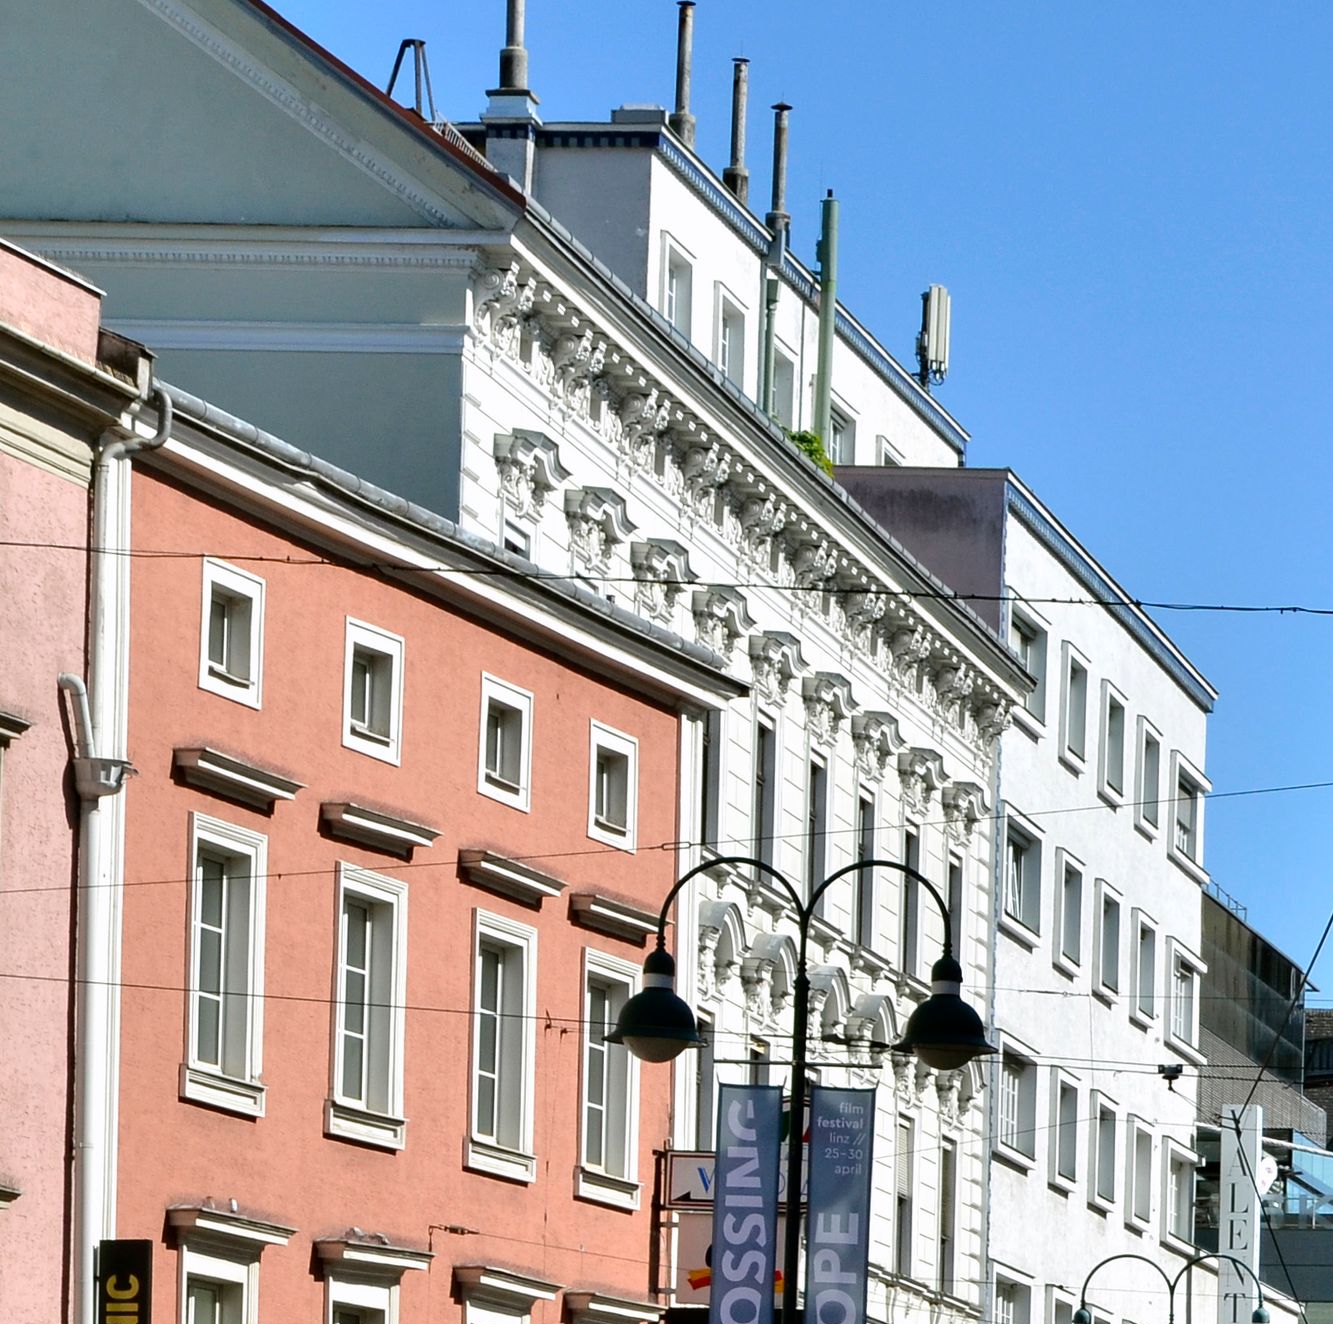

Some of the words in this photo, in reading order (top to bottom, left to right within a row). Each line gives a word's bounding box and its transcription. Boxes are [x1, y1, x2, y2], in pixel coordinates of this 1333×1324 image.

[838, 1102, 865, 1114] film
[816, 1117, 864, 1130] festival
[828, 1133, 850, 1145] linz
[834, 1163, 863, 1176] april
